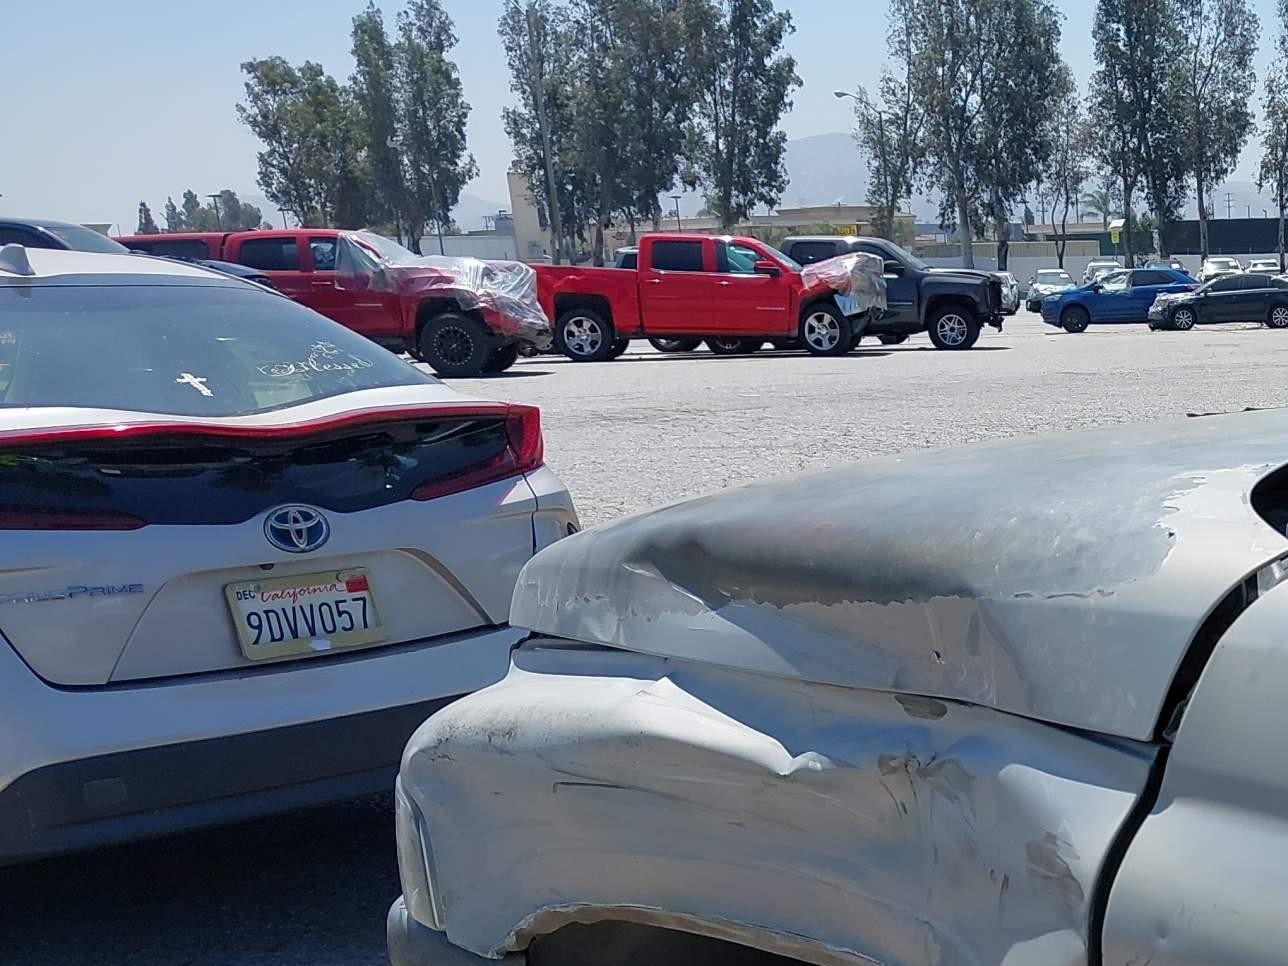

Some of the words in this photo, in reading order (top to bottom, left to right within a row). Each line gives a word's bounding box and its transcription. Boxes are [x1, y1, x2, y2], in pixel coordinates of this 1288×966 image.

[67, 583, 144, 598] PRIME
[236, 589, 256, 601] DEC
[261, 582, 345, 603] California
[246, 597, 369, 645] 9DVV057
